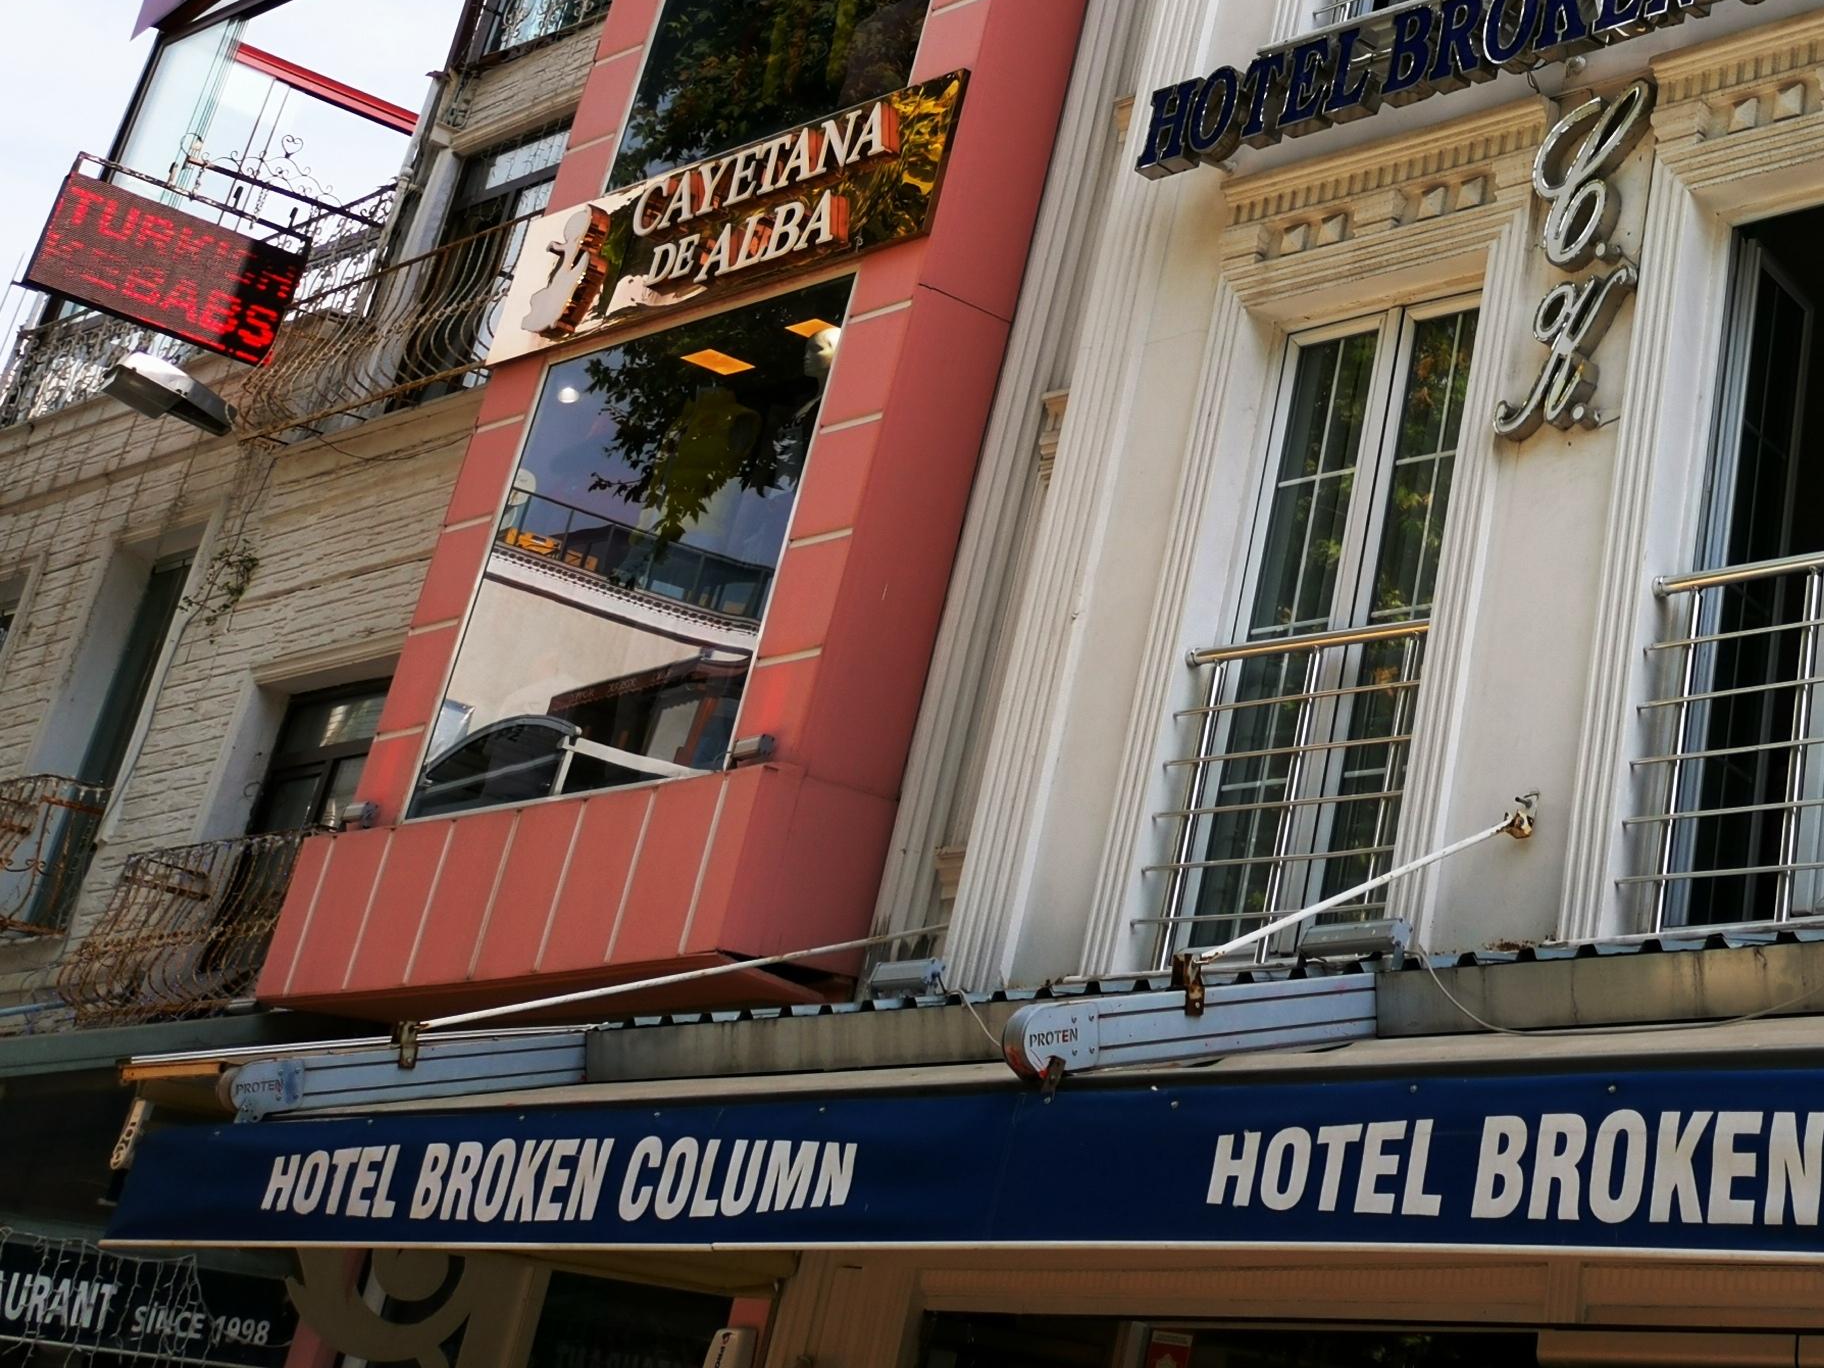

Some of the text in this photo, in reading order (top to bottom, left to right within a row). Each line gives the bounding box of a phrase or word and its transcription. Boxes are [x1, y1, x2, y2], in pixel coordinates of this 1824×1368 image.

[1135, 28, 1372, 177] HOTEL
[632, 101, 888, 237] CAYETANA
[645, 189, 834, 284] DE ALBA
[1029, 1028, 1078, 1048] PROTEN
[235, 1078, 284, 1095] PROTEN
[260, 1135, 858, 1222] HOTEL BROKEN COLUMN
[1206, 1118, 1442, 1217] HOTEL
[212, 1315, 270, 1348] 1998
